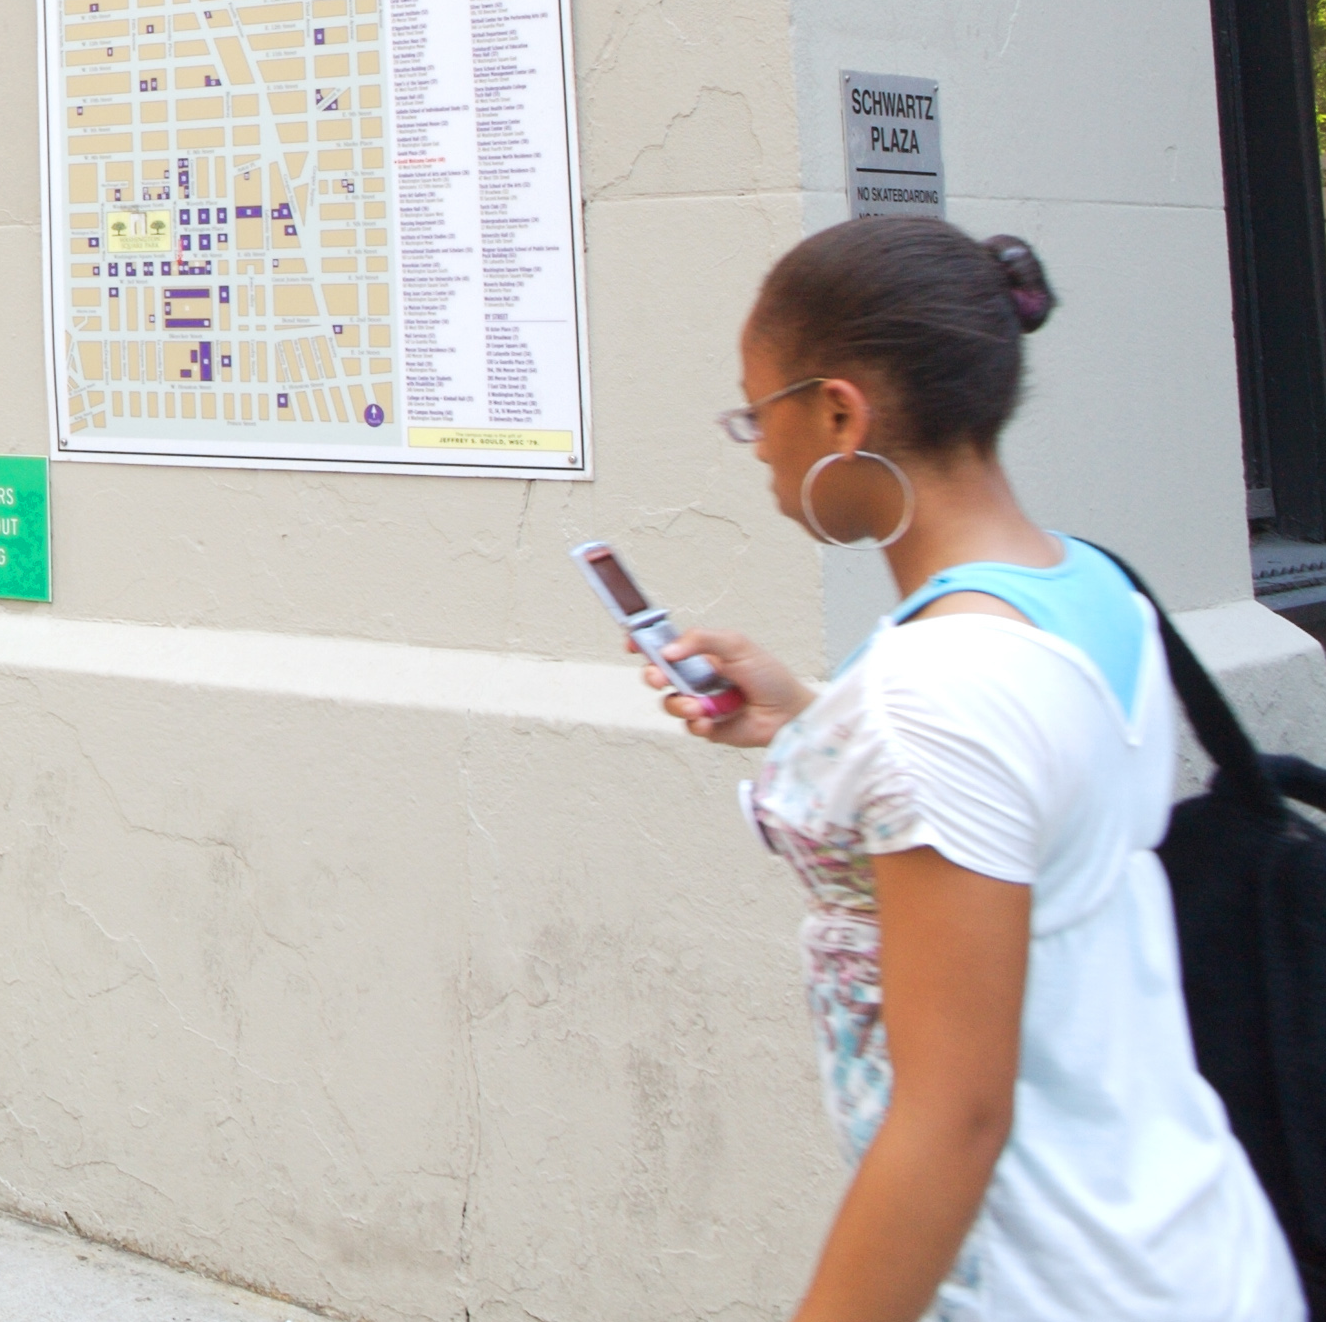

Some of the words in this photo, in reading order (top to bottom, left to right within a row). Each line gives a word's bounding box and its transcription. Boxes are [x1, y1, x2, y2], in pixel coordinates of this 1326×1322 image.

[851, 88, 934, 120] SCHWARTZ
[871, 126, 920, 154] PLAZA
[857, 186, 869, 201] NO
[871, 187, 939, 204] SKATEBOARDING
